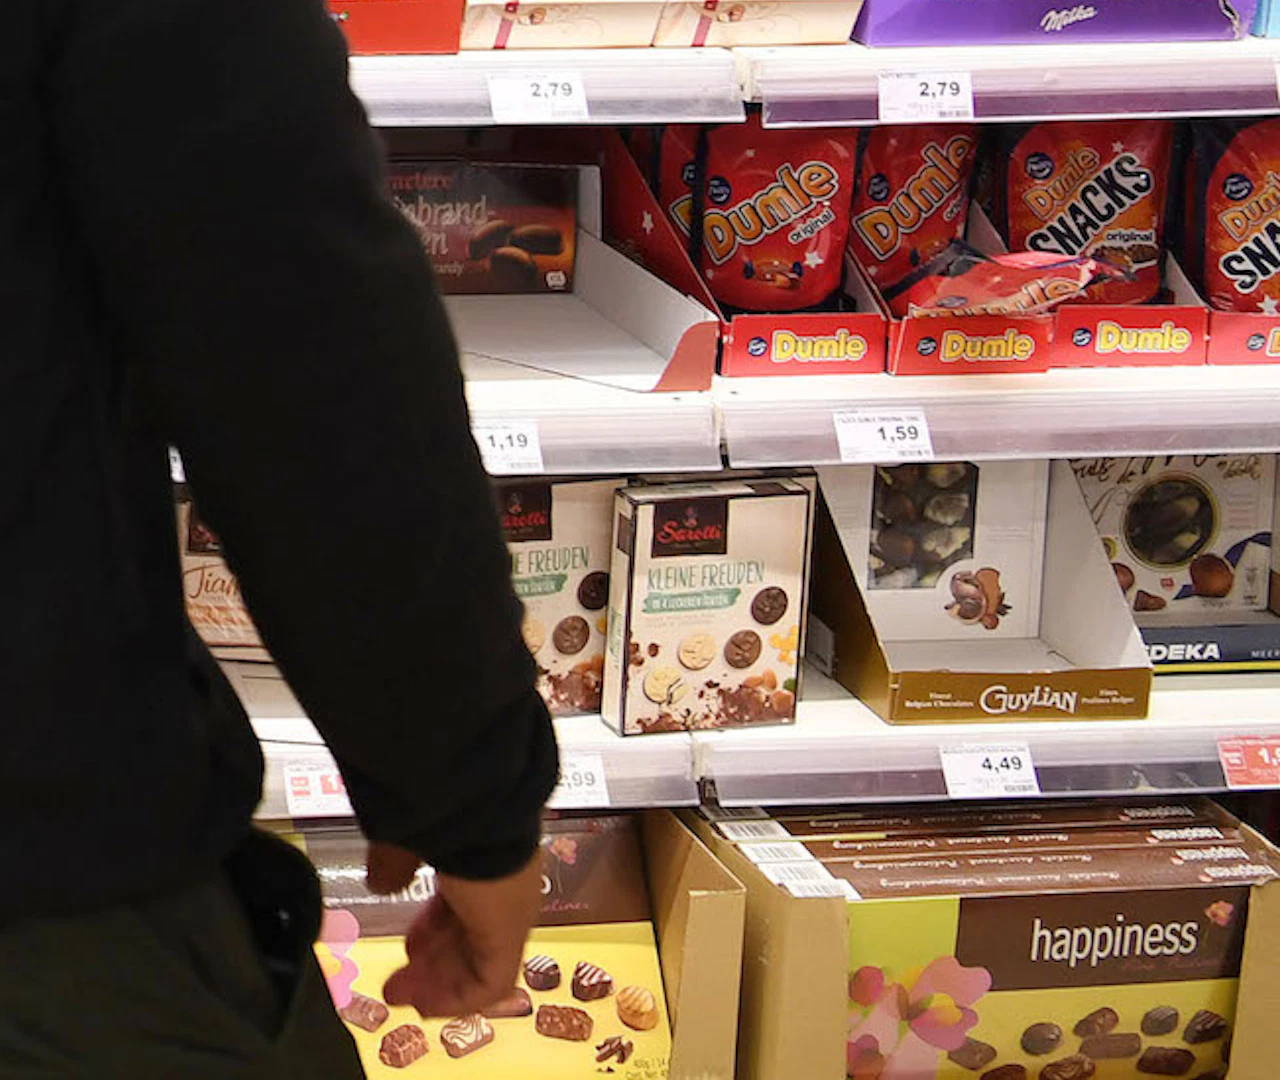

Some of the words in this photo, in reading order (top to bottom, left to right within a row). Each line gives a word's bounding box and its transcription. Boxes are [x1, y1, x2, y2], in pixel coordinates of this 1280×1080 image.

[1040, 5, 1098, 33] Milka
[530, 82, 573, 98] 2,79
[919, 81, 961, 99] 2,79
[702, 159, 839, 265] Dumle
[853, 134, 975, 261] Dumle
[1026, 151, 1154, 255] SNACKS
[788, 207, 835, 245] original
[1105, 231, 1156, 244] original
[772, 329, 868, 361] Dumle
[941, 329, 1036, 359] Dumle
[1095, 322, 1192, 352] Dumle
[487, 433, 529, 451] 1,19
[876, 425, 920, 442] 1,59
[657, 520, 723, 544] Sarotti
[528, 546, 590, 574] FREUDEN
[646, 564, 697, 591] KLEINE
[700, 560, 765, 588] FREUDEN
[981, 756, 1023, 774] 4,49
[1031, 913, 1200, 968] happiness
